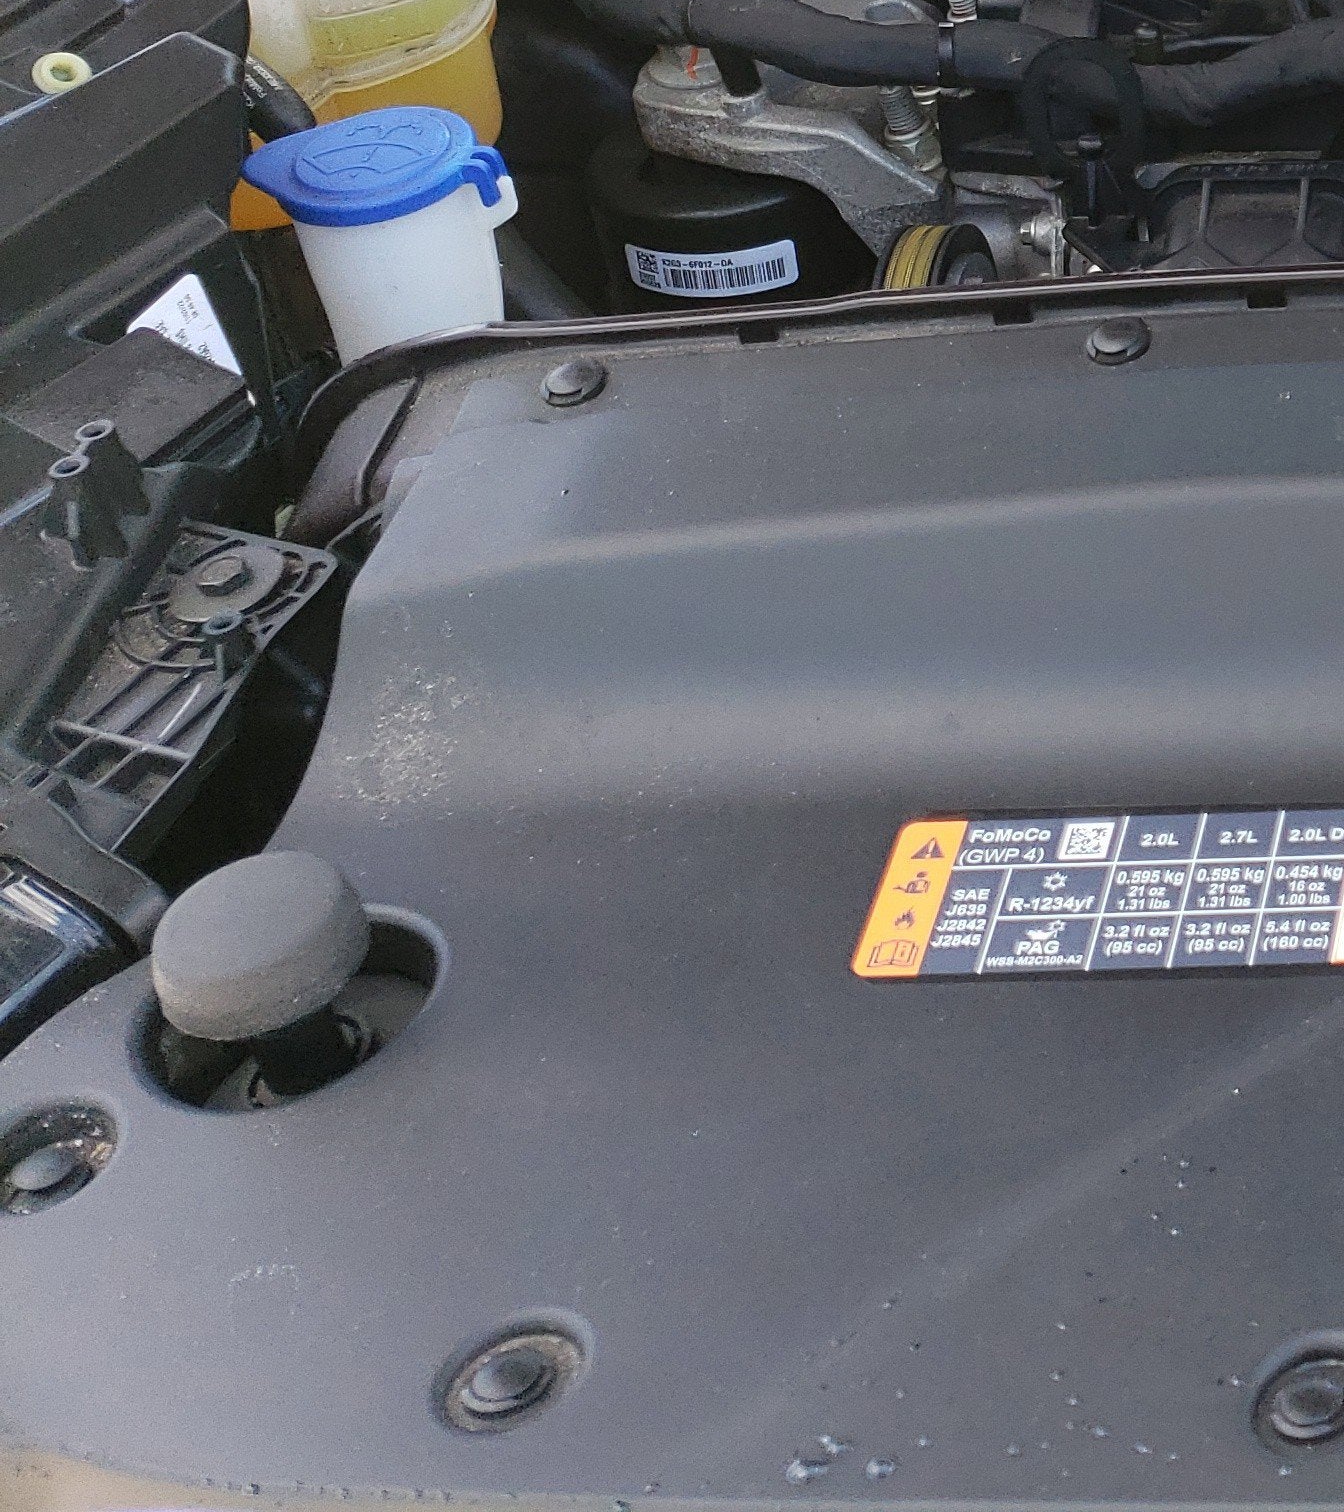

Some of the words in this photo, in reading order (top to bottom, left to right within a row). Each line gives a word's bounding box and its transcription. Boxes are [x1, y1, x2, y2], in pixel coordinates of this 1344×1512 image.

[970, 827, 1051, 843] FoMoCo
[1141, 833, 1179, 847] 2.0L
[1219, 830, 1258, 845] 2.7L
[1289, 828, 1326, 842] 2.0L
[1330, 827, 1344, 840] D
[959, 848, 1020, 865] (GWP
[1023, 847, 1045, 864] 4)
[1117, 870, 1160, 884] 0.595
[1163, 869, 1185, 886] kg
[1197, 868, 1240, 883] 0.595
[1244, 867, 1265, 884] kg
[1276, 866, 1319, 881] 0.454
[1322, 865, 1344, 883] kg
[1128, 886, 1145, 897] 21
[1150, 887, 1166, 896] oz
[1209, 884, 1225, 895] 21
[1229, 884, 1246, 894] oz
[1289, 881, 1305, 892] 16
[1309, 881, 1326, 891] oz
[952, 888, 990, 901] SAE
[1198, 896, 1225, 908] 1.31
[1230, 895, 1251, 906] lbs
[1278, 894, 1305, 905] 1.00
[1310, 893, 1331, 904] lbs
[944, 904, 987, 916] J639
[1008, 895, 1095, 913] R-1234yf
[1118, 898, 1145, 910] 1.31
[1150, 898, 1170, 909] lbs
[936, 919, 987, 932] J2842
[1104, 925, 1129, 938] 3.2
[1133, 925, 1146, 937] fl
[1150, 926, 1170, 936] oz
[1185, 923, 1211, 935] 3.2
[1215, 922, 1227, 934] fl
[1231, 923, 1251, 934] oz
[1265, 921, 1291, 933] 5.4
[1294, 920, 1306, 932] fl
[1310, 921, 1331, 932] oz
[930, 934, 981, 948] J2845
[1016, 941, 1060, 955] PAG
[1106, 940, 1133, 956] (95
[1136, 939, 1163, 955] cc)
[1188, 938, 1215, 954] (95
[1218, 937, 1245, 952] cc)
[1263, 936, 1298, 951] (160
[1302, 934, 1329, 950] cc)
[986, 954, 1084, 967] WSS-M2C300-A2
